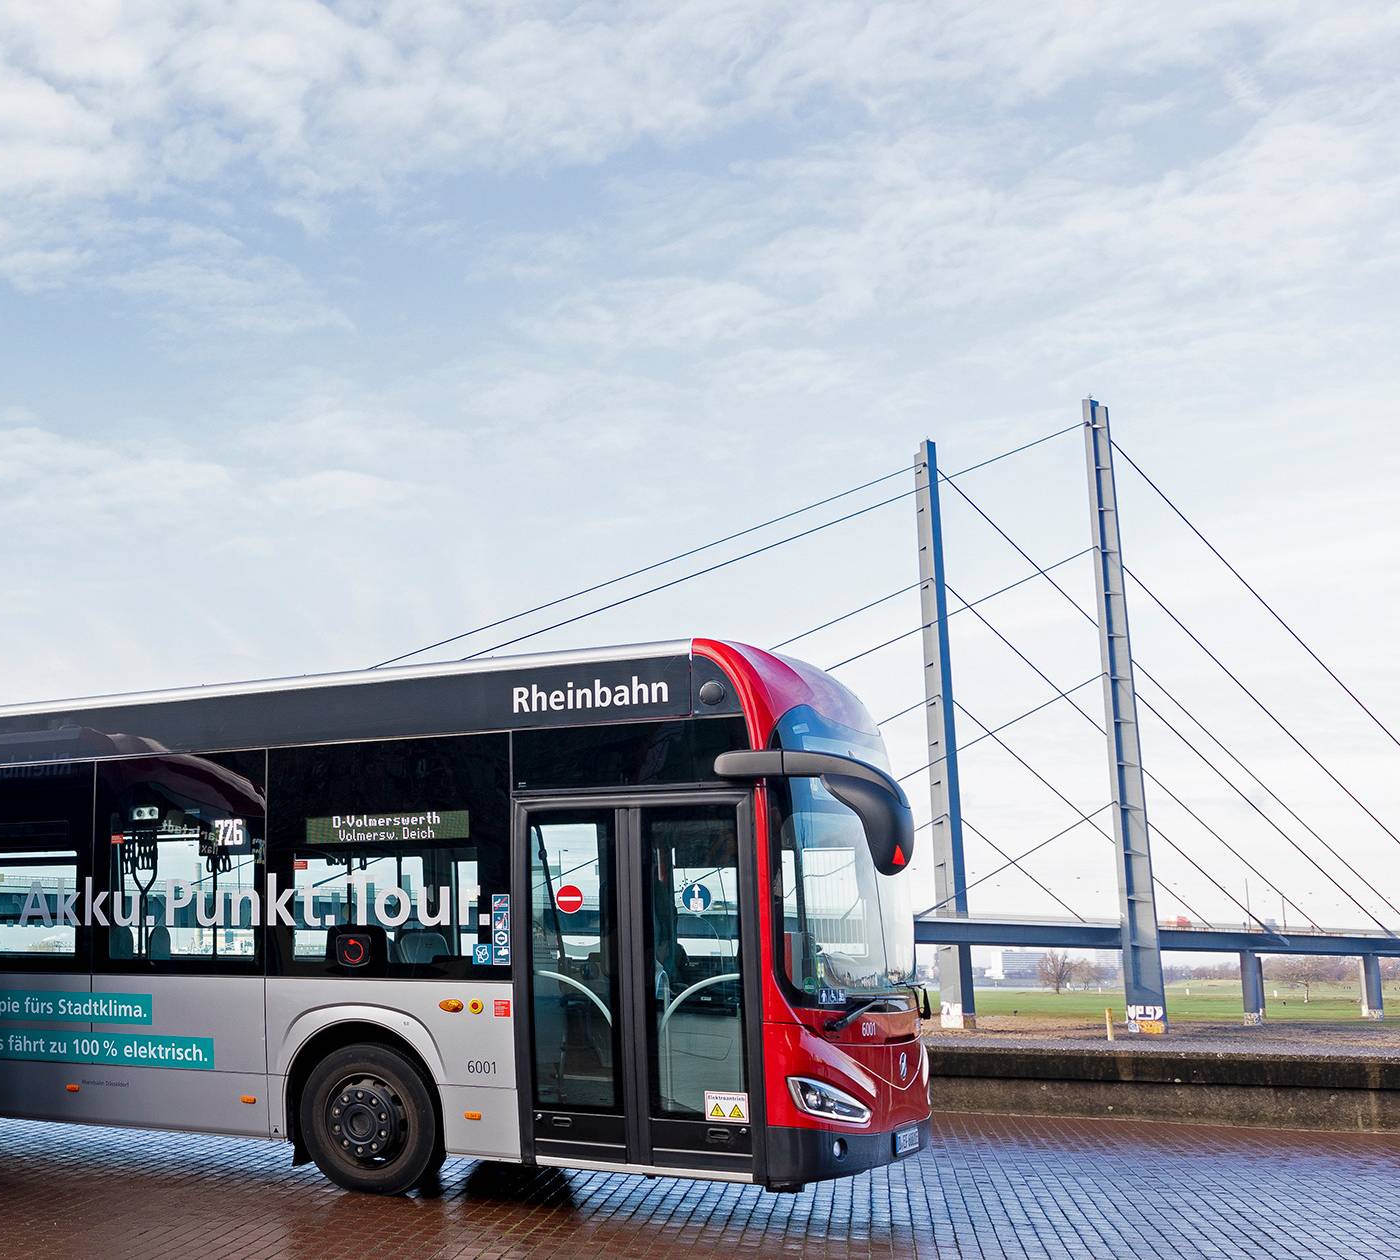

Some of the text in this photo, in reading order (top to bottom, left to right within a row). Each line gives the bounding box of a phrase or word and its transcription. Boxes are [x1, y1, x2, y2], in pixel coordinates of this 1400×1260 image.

[513, 676, 669, 713] Rheinbahn
[332, 811, 441, 829] D-Volmerswerth
[214, 819, 243, 846] 726
[338, 826, 435, 841] Volmersw. Deich
[24, 997, 54, 1014] fürs
[58, 998, 147, 1019] Stadtklima.
[862, 1022, 877, 1037] 6001
[8, 1034, 46, 1053] fährt
[49, 1041, 67, 1054] zu
[72, 1039, 100, 1056] 100
[103, 1040, 118, 1057] %
[123, 1041, 208, 1062] elektrisch.
[467, 1060, 497, 1074] 6001
